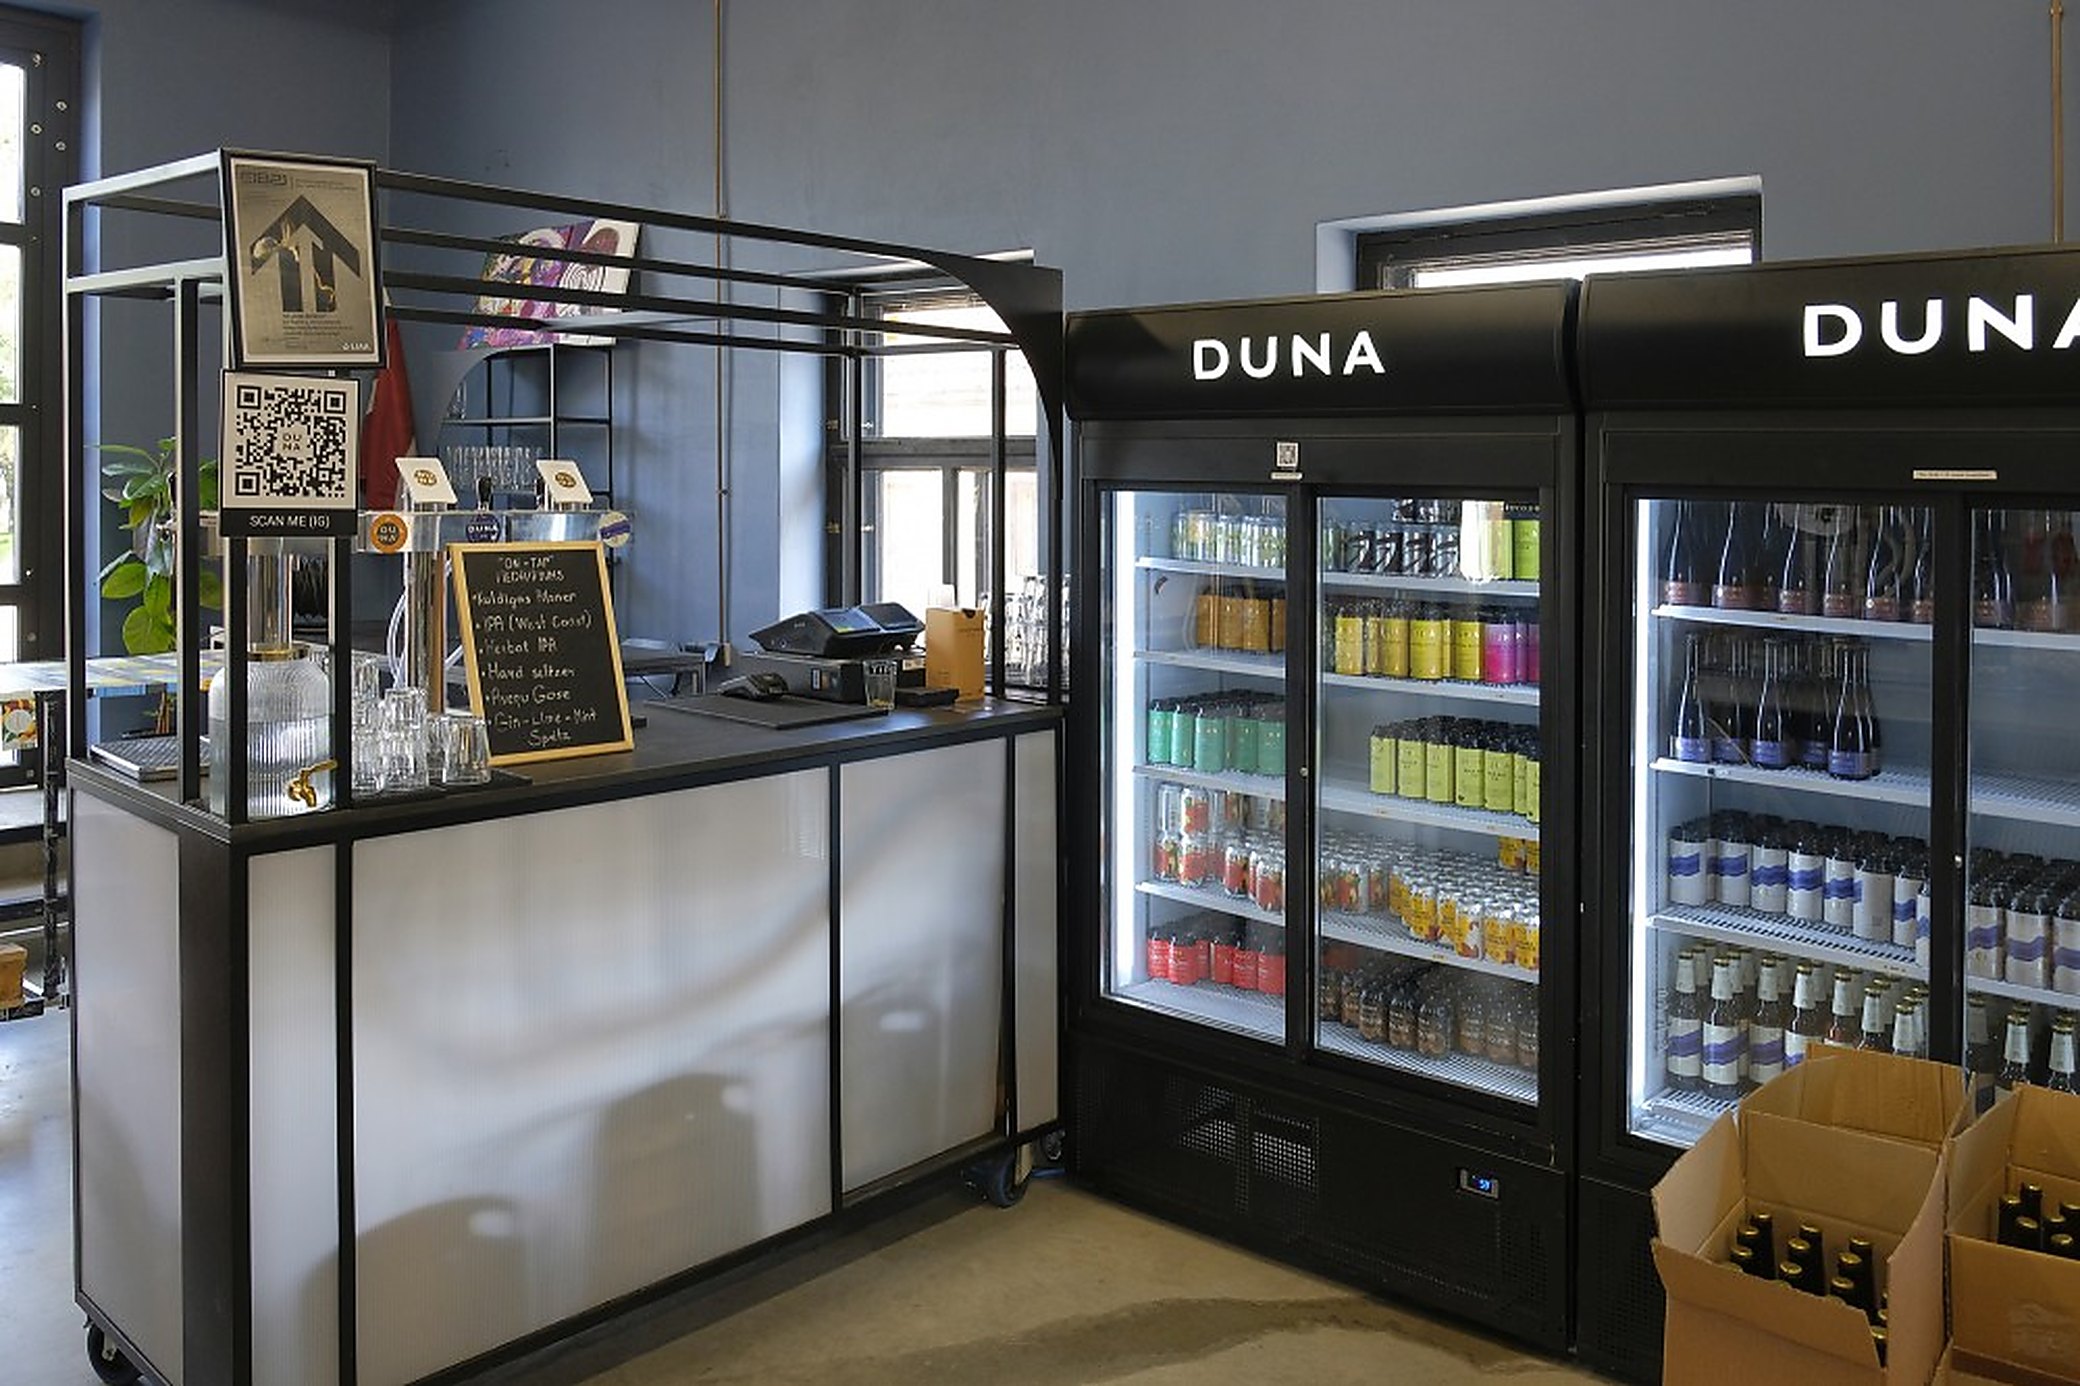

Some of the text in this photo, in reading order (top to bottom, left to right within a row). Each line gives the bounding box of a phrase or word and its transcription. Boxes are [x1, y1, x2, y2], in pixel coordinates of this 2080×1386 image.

[1193, 330, 1386, 381] DUNA
[249, 515, 330, 529] SCAN ME (IG)
[487, 662, 523, 680] Hard
[532, 684, 571, 704] Gose
